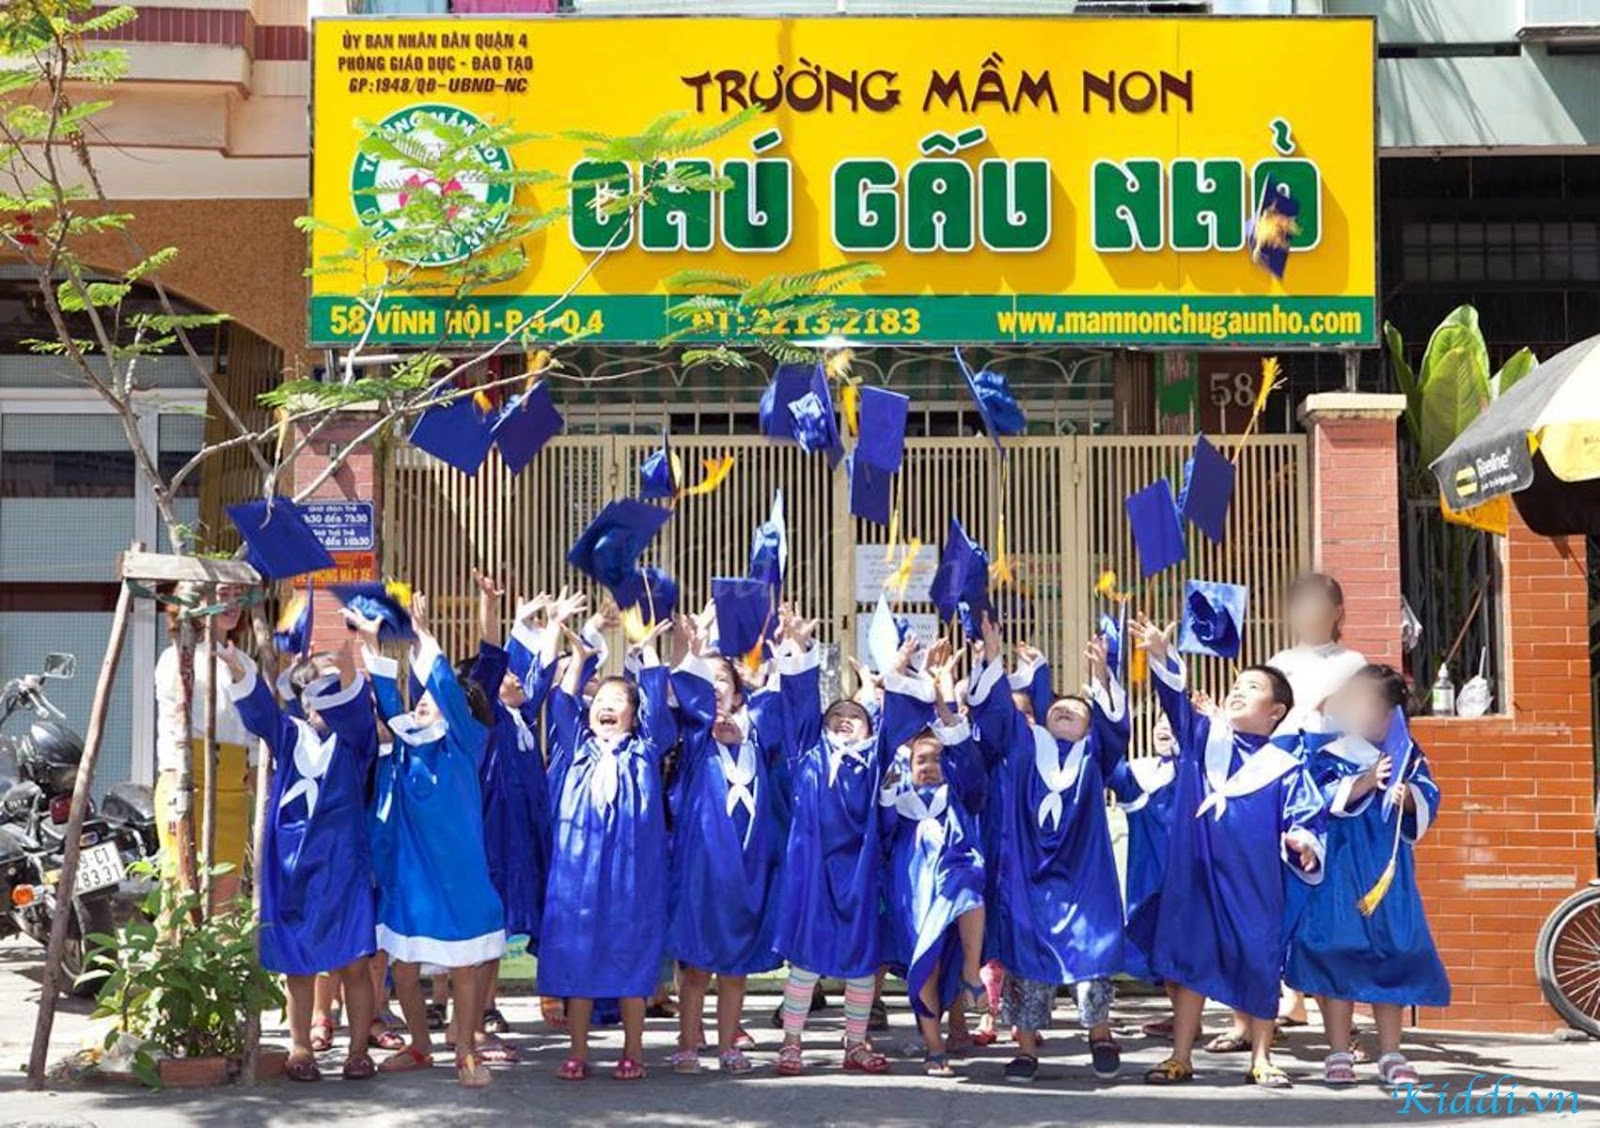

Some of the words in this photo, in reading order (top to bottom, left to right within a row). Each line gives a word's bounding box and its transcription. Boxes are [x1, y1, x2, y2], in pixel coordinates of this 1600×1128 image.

[365, 34, 394, 49] BAN
[398, 32, 437, 49] NHÂN
[441, 32, 470, 49] DÂN
[475, 33, 514, 52] QUẬN
[518, 33, 528, 49] 4
[338, 54, 385, 72] PHÒNG
[389, 54, 424, 71] GIÁO
[428, 56, 456, 75] DỤC
[471, 54, 502, 71] ĐÀO
[506, 56, 534, 75] TẠO
[681, 57, 901, 114] TRƯỜNG
[922, 52, 1059, 113] MẦM
[1082, 69, 1194, 112] NON
[569, 129, 793, 252] CHÚ
[831, 128, 1052, 252] GẤU
[1091, 118, 1322, 252] NHỎ
[330, 304, 367, 334] 58
[375, 304, 436, 334] VĨNH
[997, 304, 1361, 338] www.mamnonchugaunho.com
[1210, 372, 1255, 407] 58
